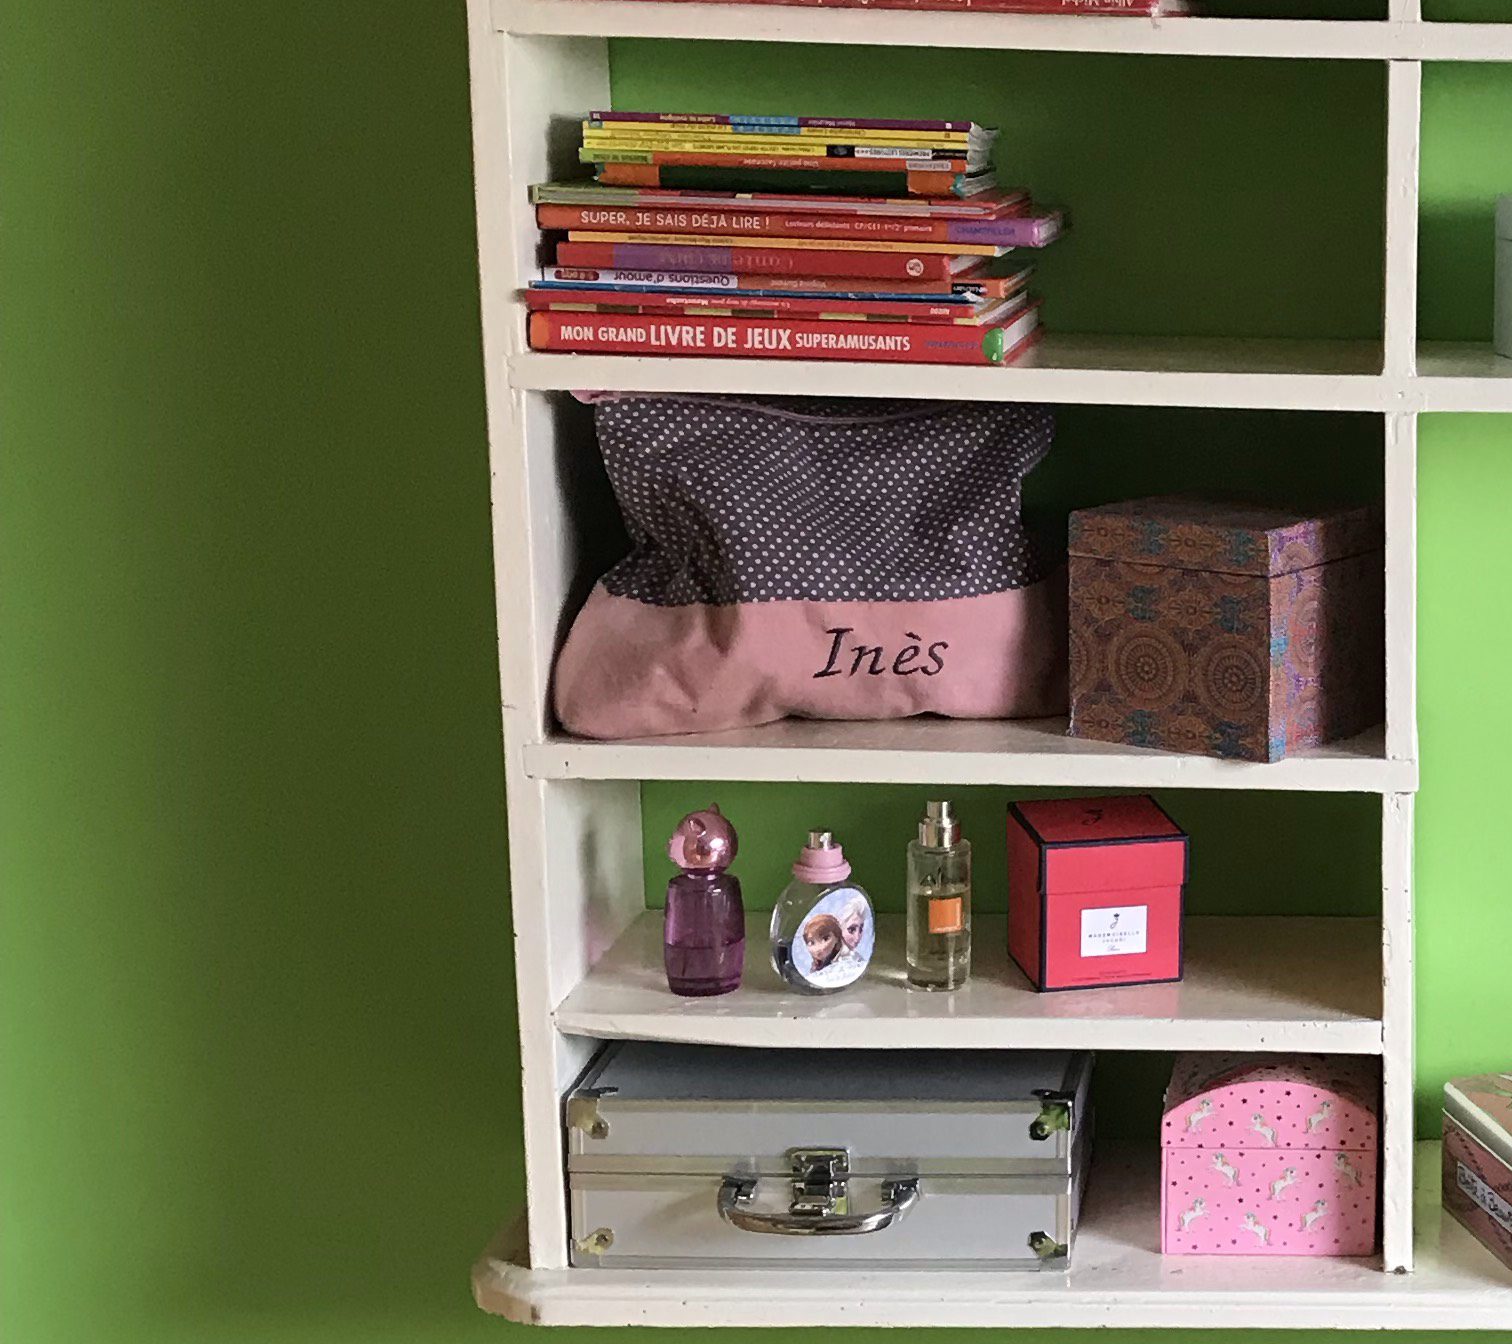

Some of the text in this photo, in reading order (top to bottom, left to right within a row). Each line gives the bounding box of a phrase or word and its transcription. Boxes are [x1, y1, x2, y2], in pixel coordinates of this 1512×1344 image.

[635, 213, 652, 227] JE
[655, 213, 688, 228] SAIS
[691, 211, 728, 229] DÉJÀ
[731, 214, 761, 229] LIRE
[612, 269, 732, 289] Questions d'amour
[560, 324, 911, 352] MON GRAND LIVRE DE JEUX SUPERAMUSANTS
[812, 625, 949, 679] Inès
